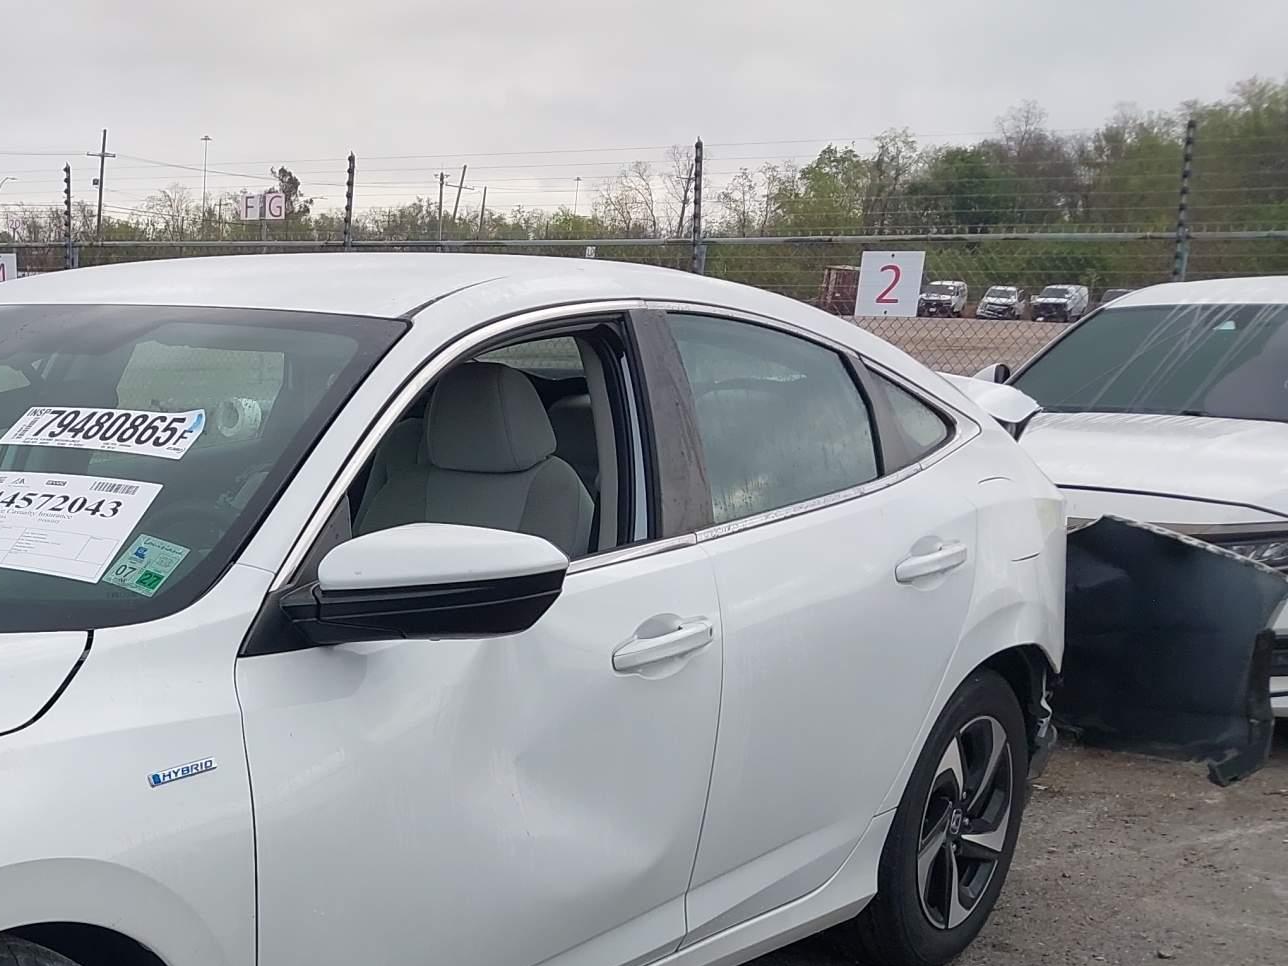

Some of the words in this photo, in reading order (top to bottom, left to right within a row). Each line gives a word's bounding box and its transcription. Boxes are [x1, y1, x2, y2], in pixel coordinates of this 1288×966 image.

[245, 195, 255, 218] F
[269, 195, 283, 218] G
[875, 264, 901, 304] 2
[32, 409, 187, 448] 79480865
[115, 564, 137, 578] 07
[140, 572, 159, 590] 27
[162, 759, 213, 781] HYBRID
